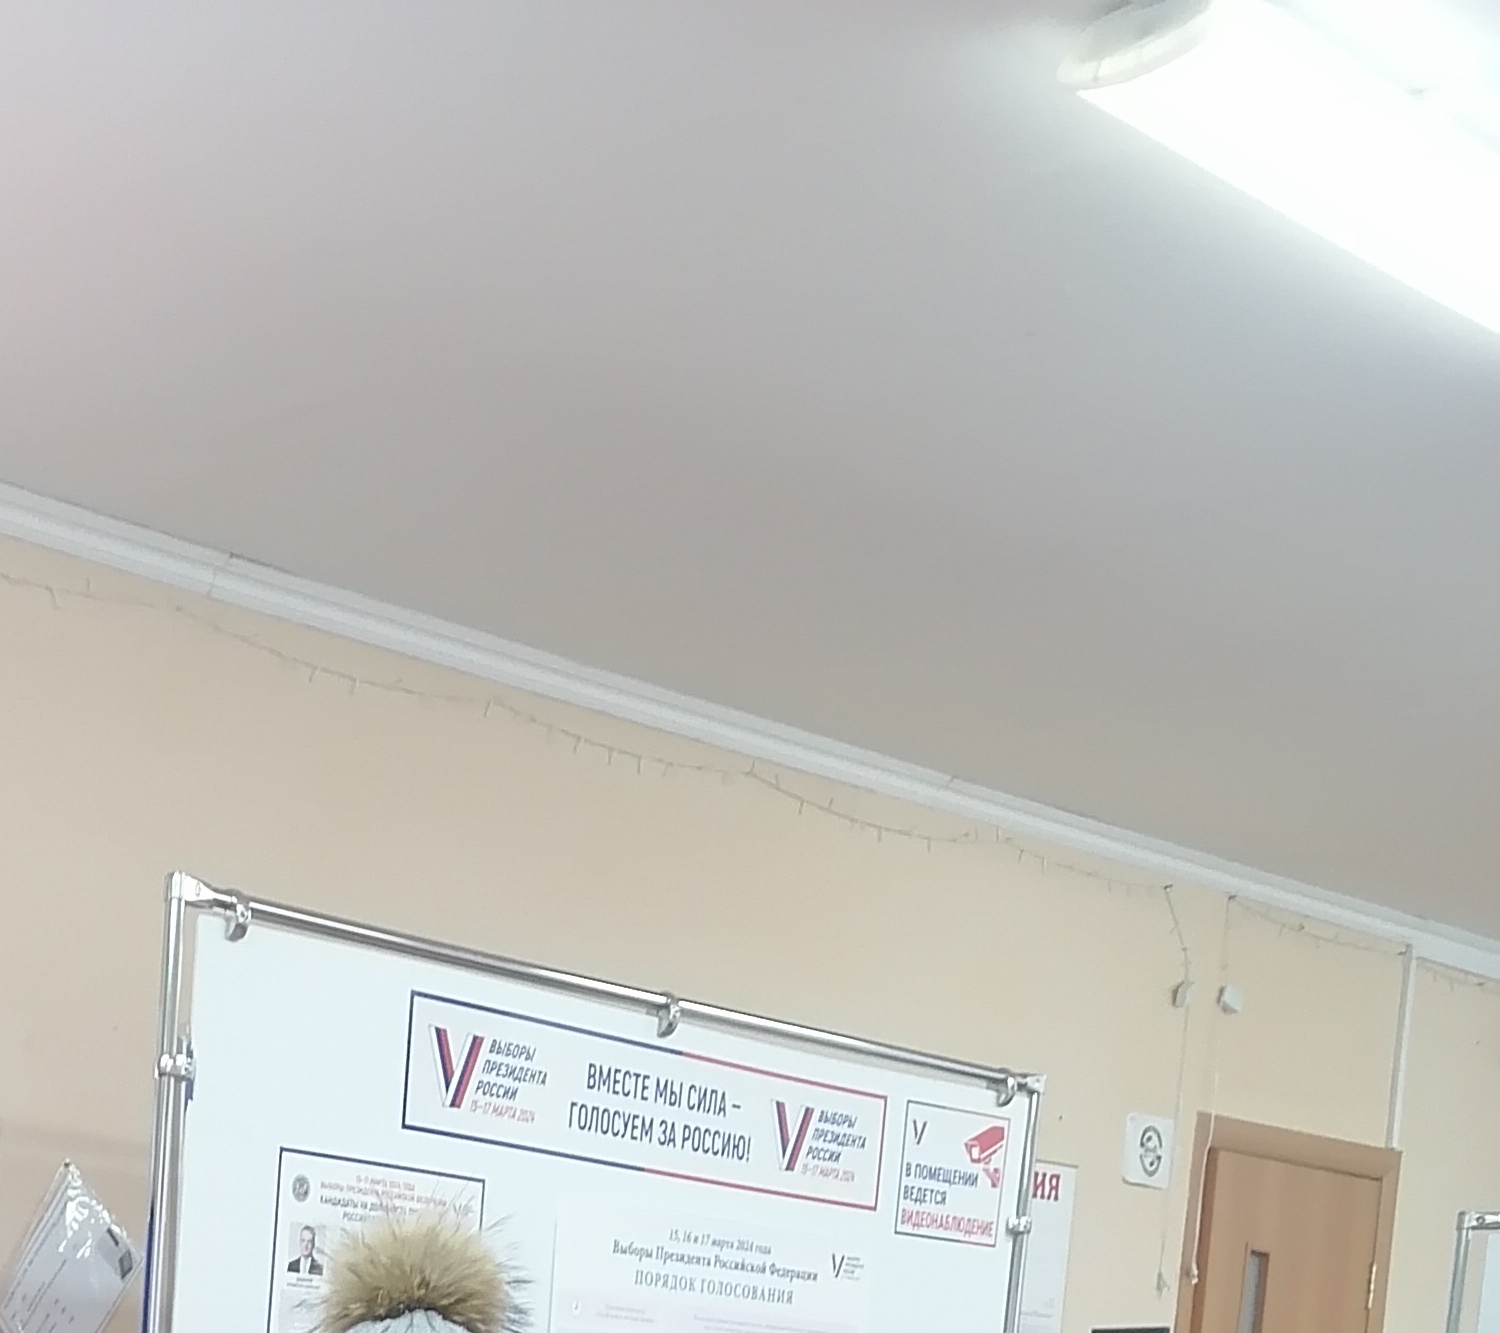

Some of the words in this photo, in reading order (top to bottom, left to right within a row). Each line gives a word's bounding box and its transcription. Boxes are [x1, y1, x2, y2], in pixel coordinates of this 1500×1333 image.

[489, 1039, 536, 1061] ВЫБОРЫ
[482, 1060, 548, 1086] ПРЕЗИДЕНТА
[475, 1081, 519, 1101] РОССИИ
[587, 1063, 650, 1101] ВМЕСТЕ
[654, 1077, 683, 1106] МЫ
[687, 1084, 727, 1118] СИЛА
[491, 1104, 516, 1120] МАРТА
[518, 1109, 536, 1124] 2024
[818, 1109, 857, 1129] ВЫБОРЫ
[569, 1101, 653, 1144] ГОЛОСУЕМ
[657, 1119, 677, 1148] ЗА
[681, 1125, 751, 1163] РОССИЮ!
[812, 1127, 867, 1151] ПРЕЗИДЕНТА
[806, 1145, 843, 1164] РОССИИ
[905, 1161, 912, 1179] В
[914, 1164, 979, 1188] ПОМЕЩЕНИИ
[903, 1187, 947, 1206] ВЕДЕТСЯ
[900, 1209, 994, 1239] ВИДЕОНАБЛЮДЕНИЕ
[700, 1233, 710, 1246] 17
[612, 1239, 652, 1262] Выборы
[655, 1247, 711, 1268] Президента
[714, 1254, 767, 1275] Российской
[768, 1262, 818, 1283] Федерации
[635, 1269, 696, 1292] ПОРЯДОК
[700, 1278, 794, 1305] ГОЛОСОВАНИЯ
